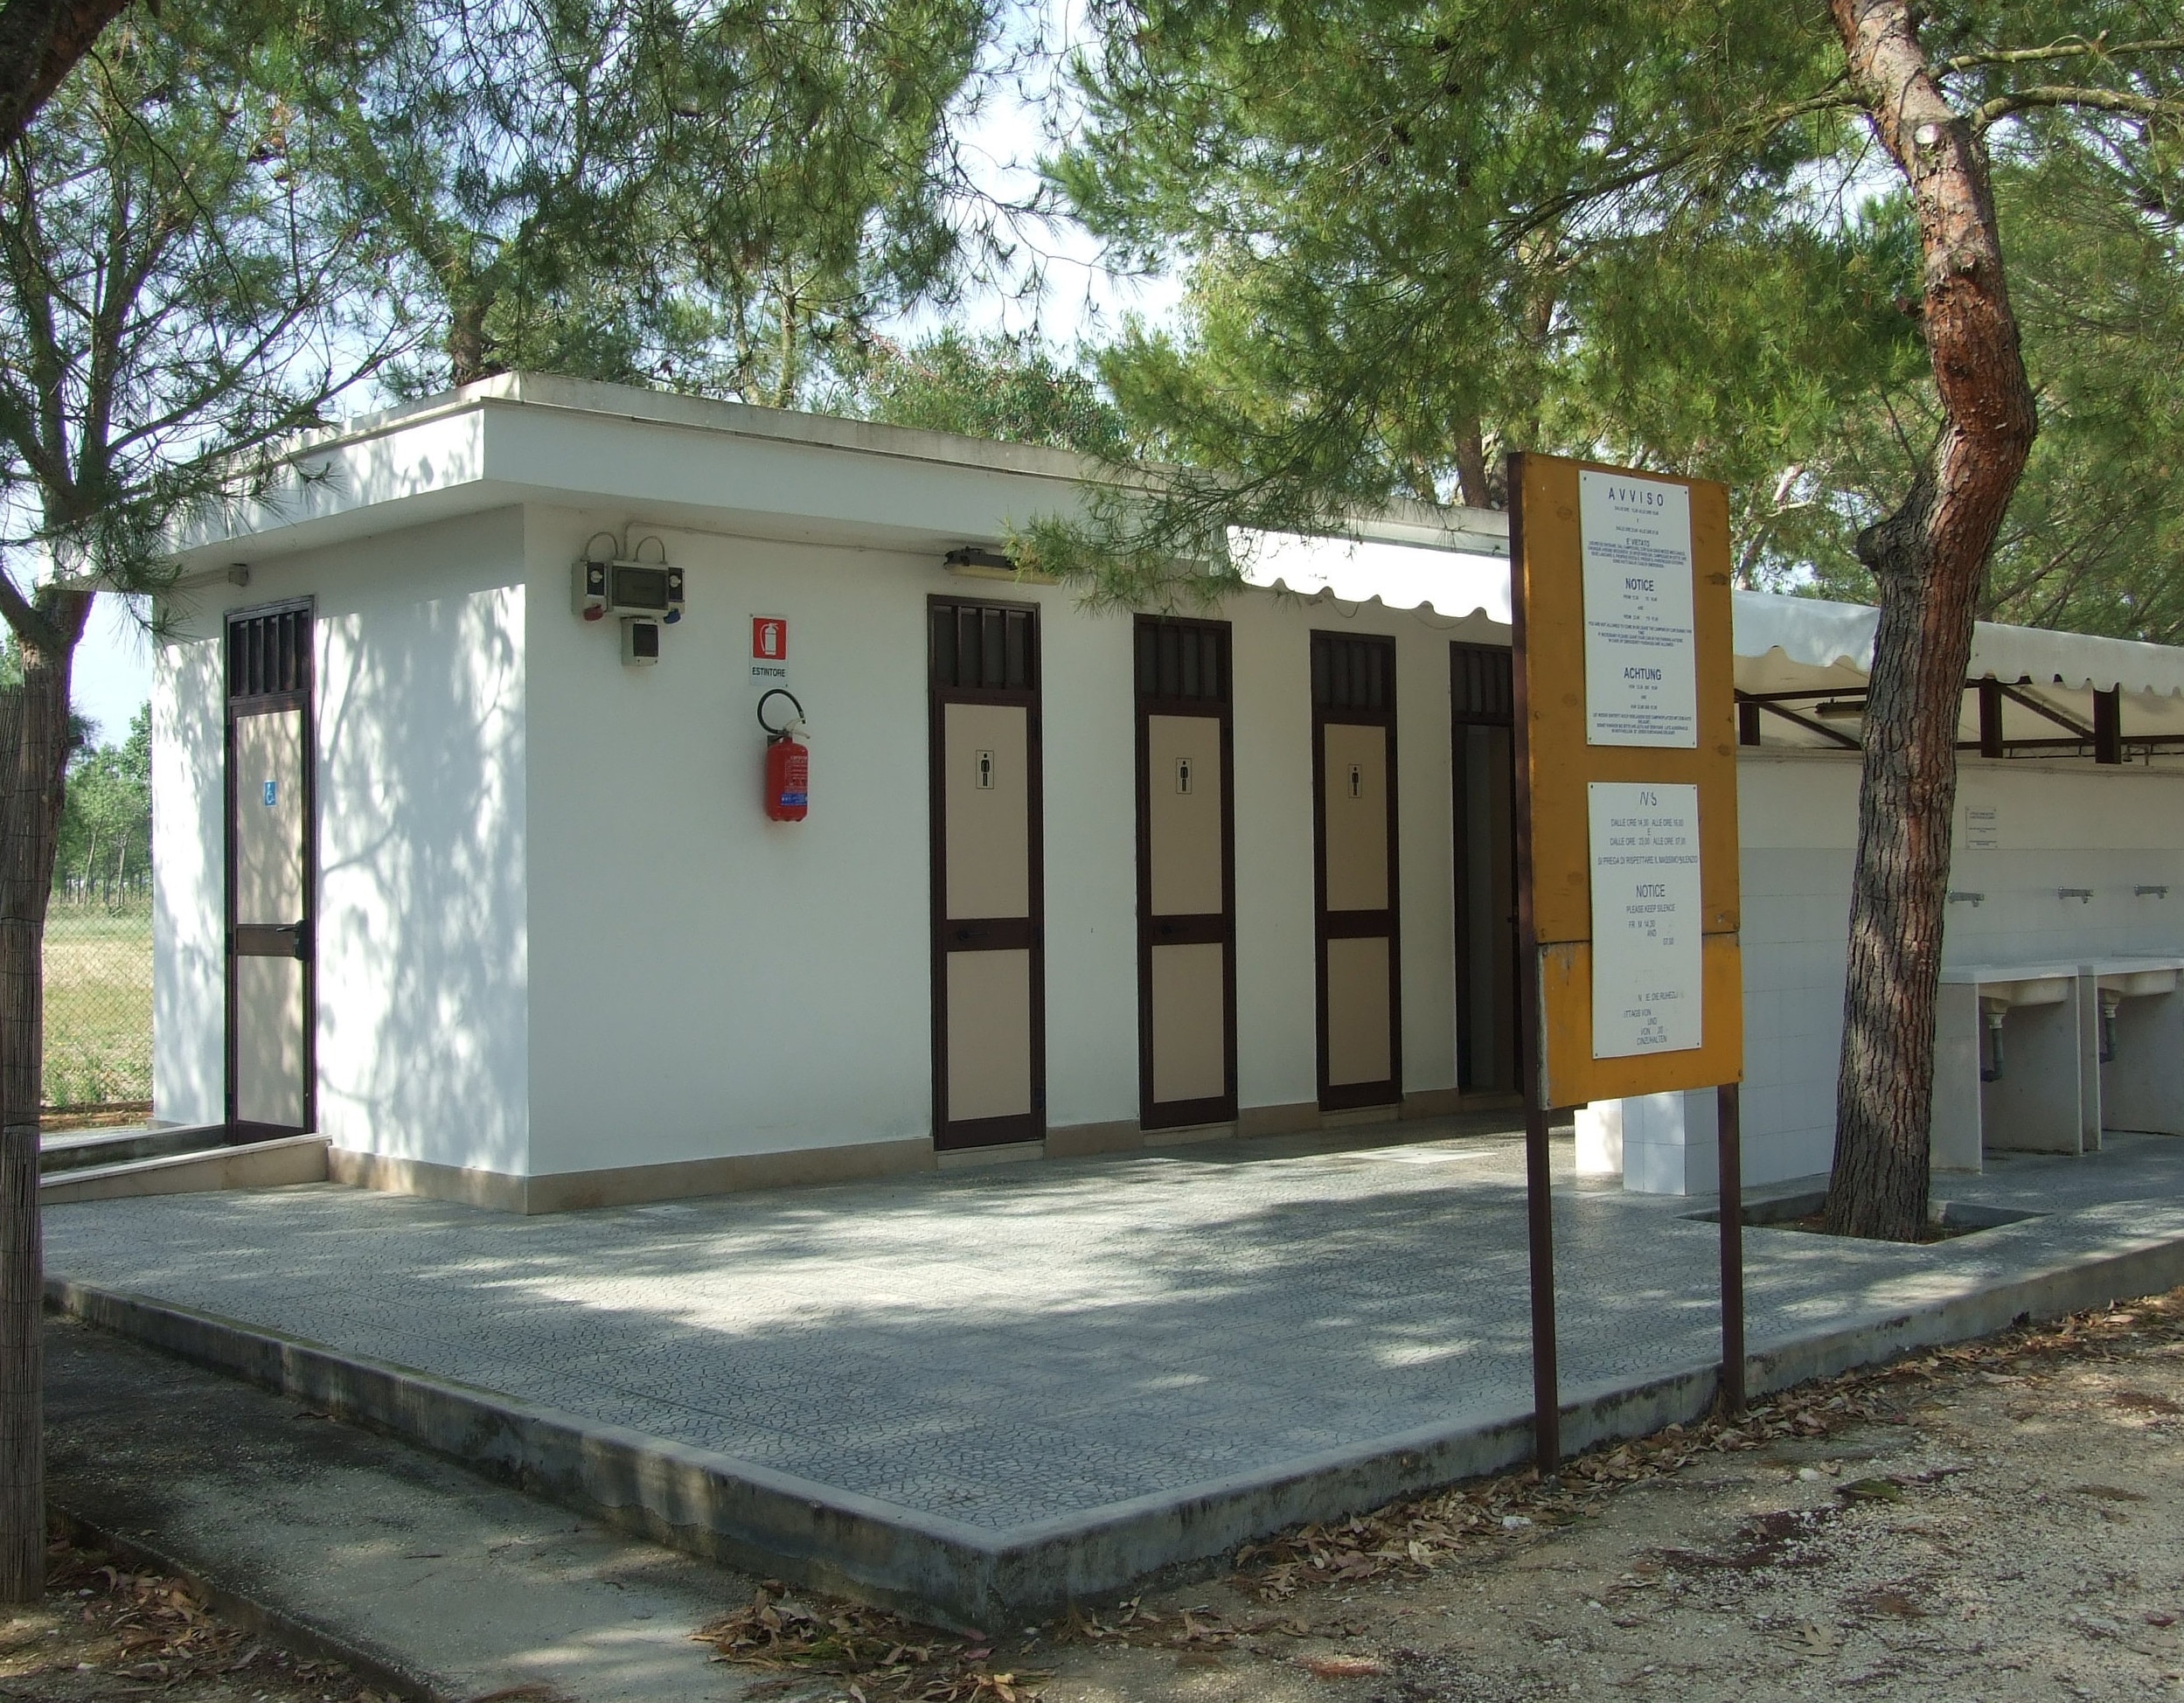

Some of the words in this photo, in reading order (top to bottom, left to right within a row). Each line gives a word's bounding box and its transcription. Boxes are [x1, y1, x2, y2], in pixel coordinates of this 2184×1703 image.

[1609, 487, 1664, 506] AVVISO
[1625, 578, 1654, 592] NOTICE
[752, 666, 786, 678] ESTINTORE
[1624, 667, 1661, 680] ACHTUNG
[1636, 884, 1666, 899] NOTICE
